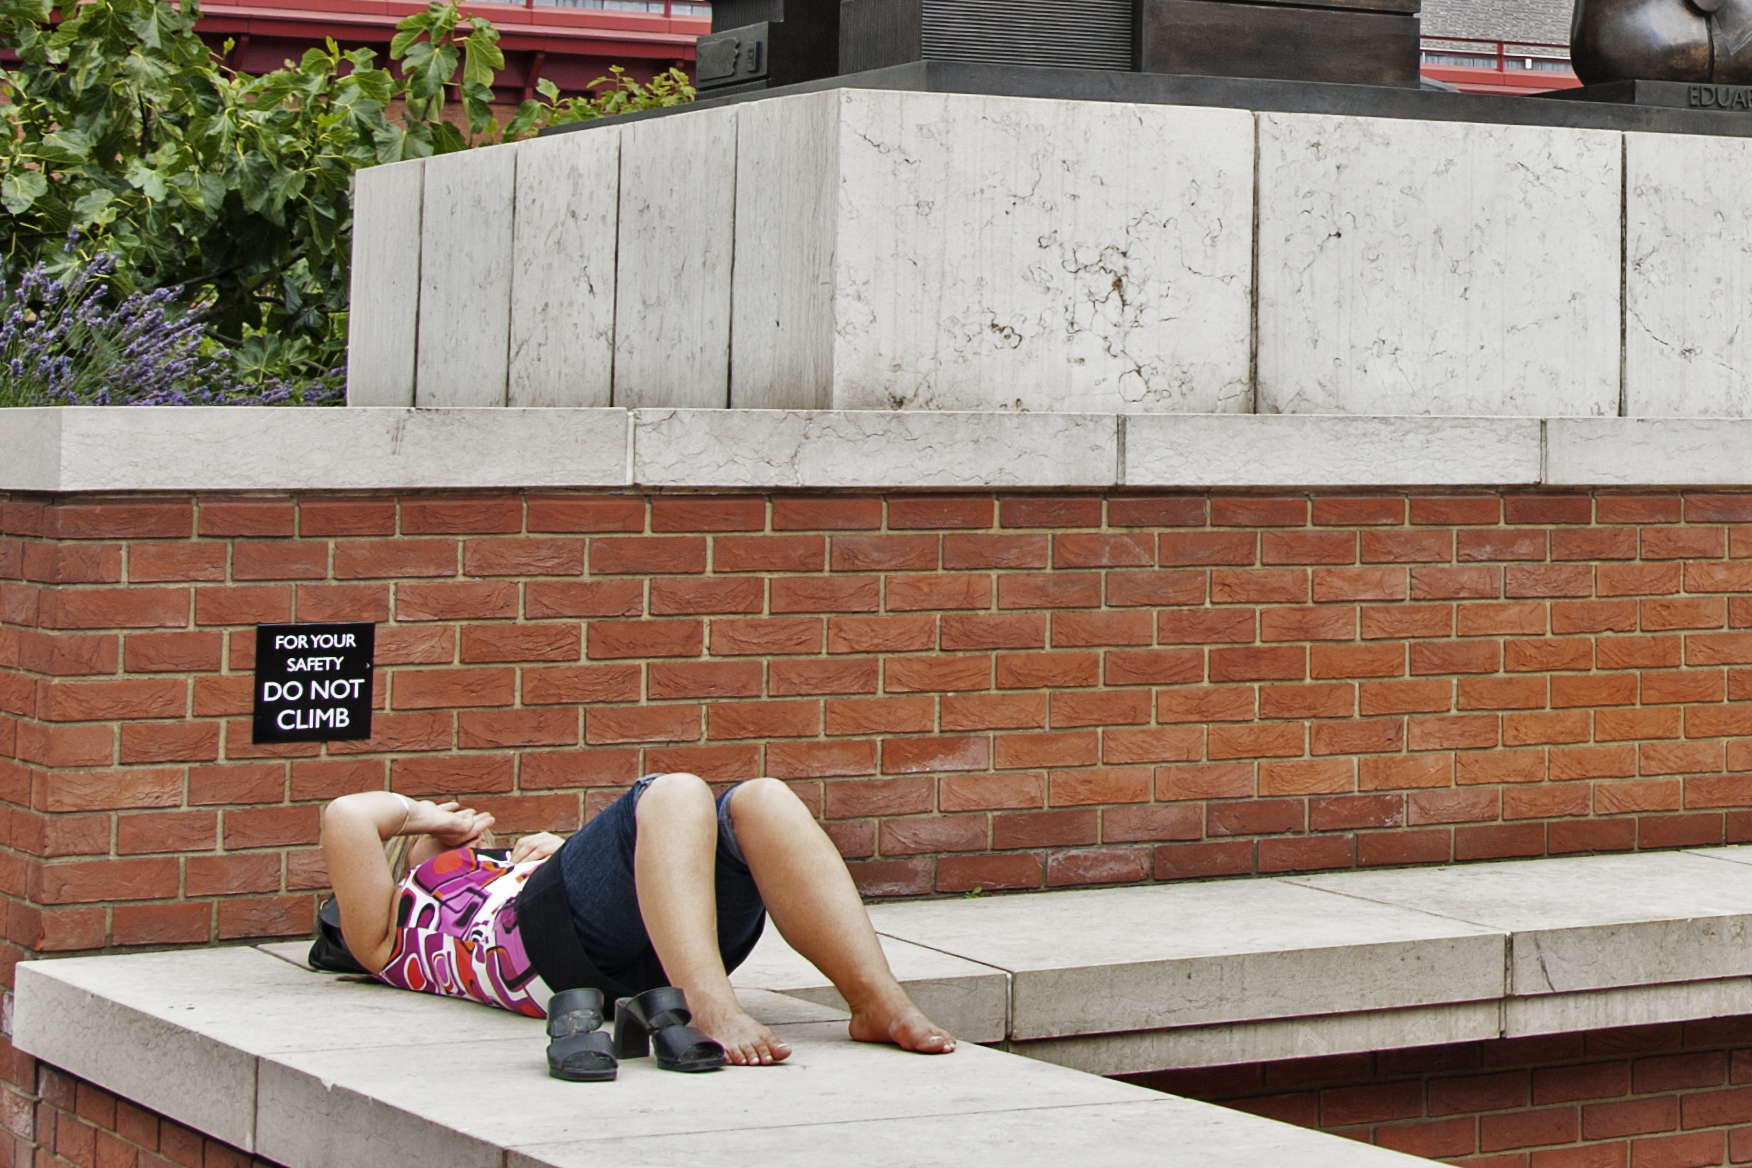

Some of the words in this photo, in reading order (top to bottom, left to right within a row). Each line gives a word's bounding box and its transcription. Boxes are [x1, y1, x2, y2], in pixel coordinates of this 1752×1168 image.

[275, 635, 309, 650] FOR
[310, 633, 356, 649] YOUR
[286, 656, 344, 672] SAFETY
[263, 680, 303, 702] DO
[310, 679, 365, 700] NOT
[277, 708, 350, 730] CLIMB
